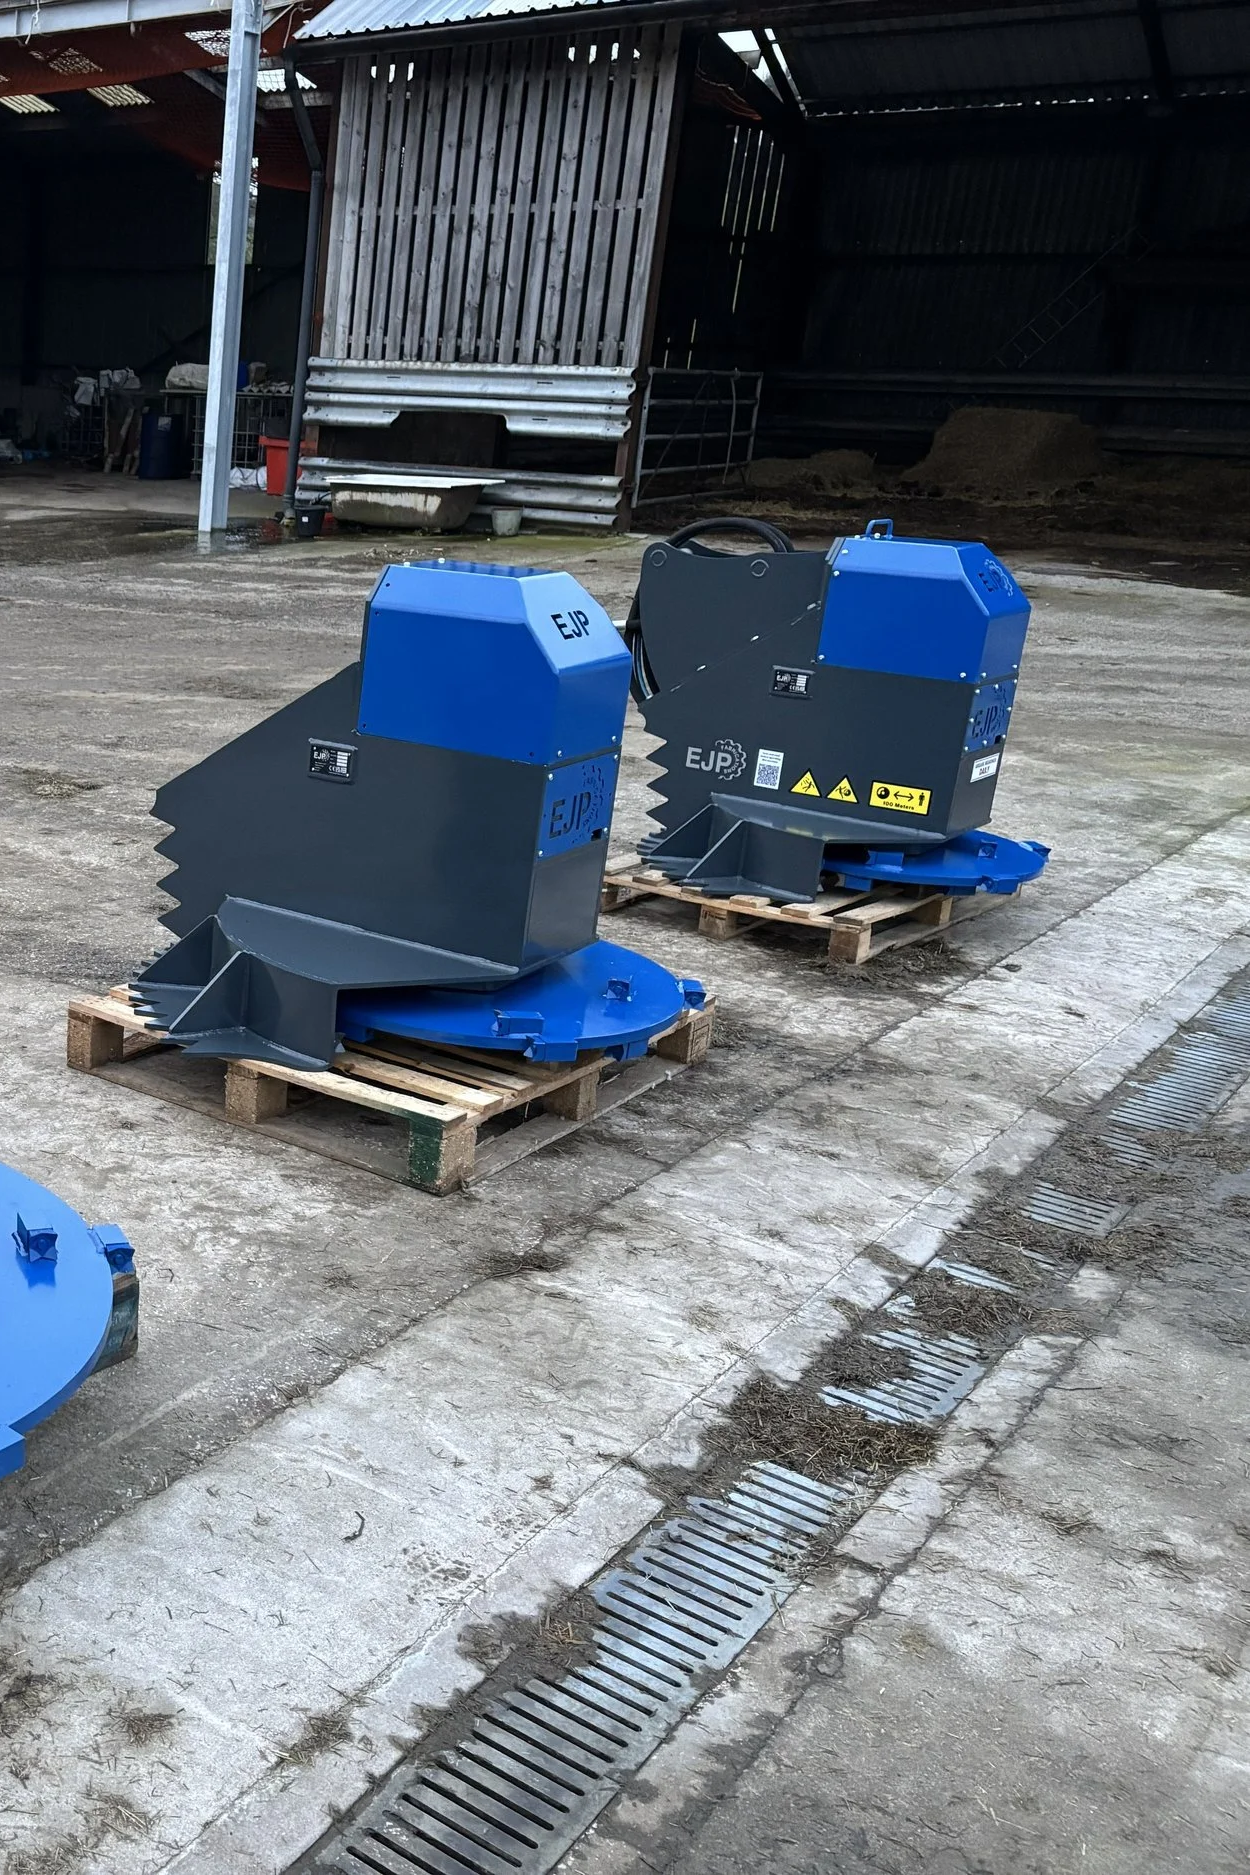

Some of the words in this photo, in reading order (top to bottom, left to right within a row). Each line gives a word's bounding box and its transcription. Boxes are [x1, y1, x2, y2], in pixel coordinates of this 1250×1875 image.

[550, 610, 590, 640] EJP
[686, 746, 732, 774] EJP
[549, 792, 591, 839] EJP
